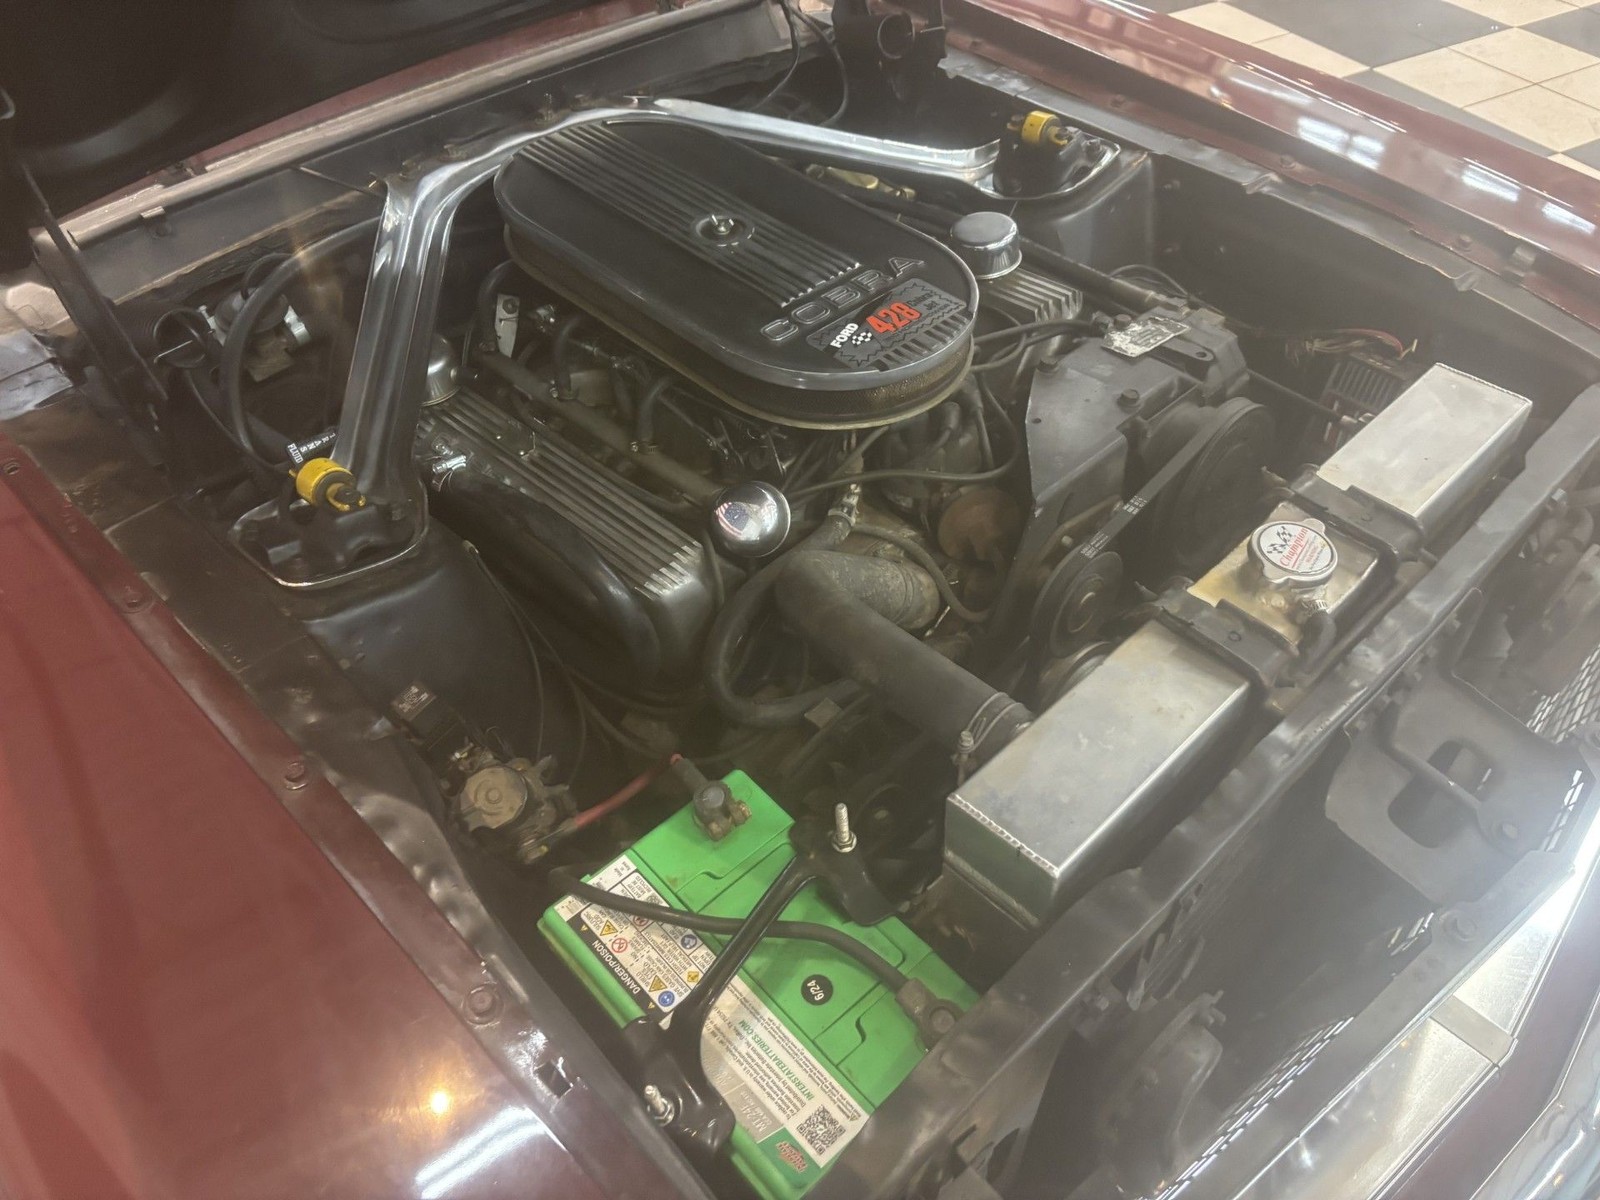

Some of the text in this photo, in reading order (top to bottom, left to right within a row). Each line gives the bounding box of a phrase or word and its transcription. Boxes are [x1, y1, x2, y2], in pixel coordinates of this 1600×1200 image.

[760, 256, 925, 341] COBRA
[865, 302, 921, 334] 428
[829, 322, 859, 349] FORD
[287, 442, 304, 464] FLUID
[300, 432, 336, 453] TRANS
[1279, 526, 1309, 568] Champion
[591, 939, 642, 994] DANGER/POISON
[806, 979, 825, 1001] 6/24
[738, 1018, 814, 1101] INTERSTATEBATTERIES.COM
